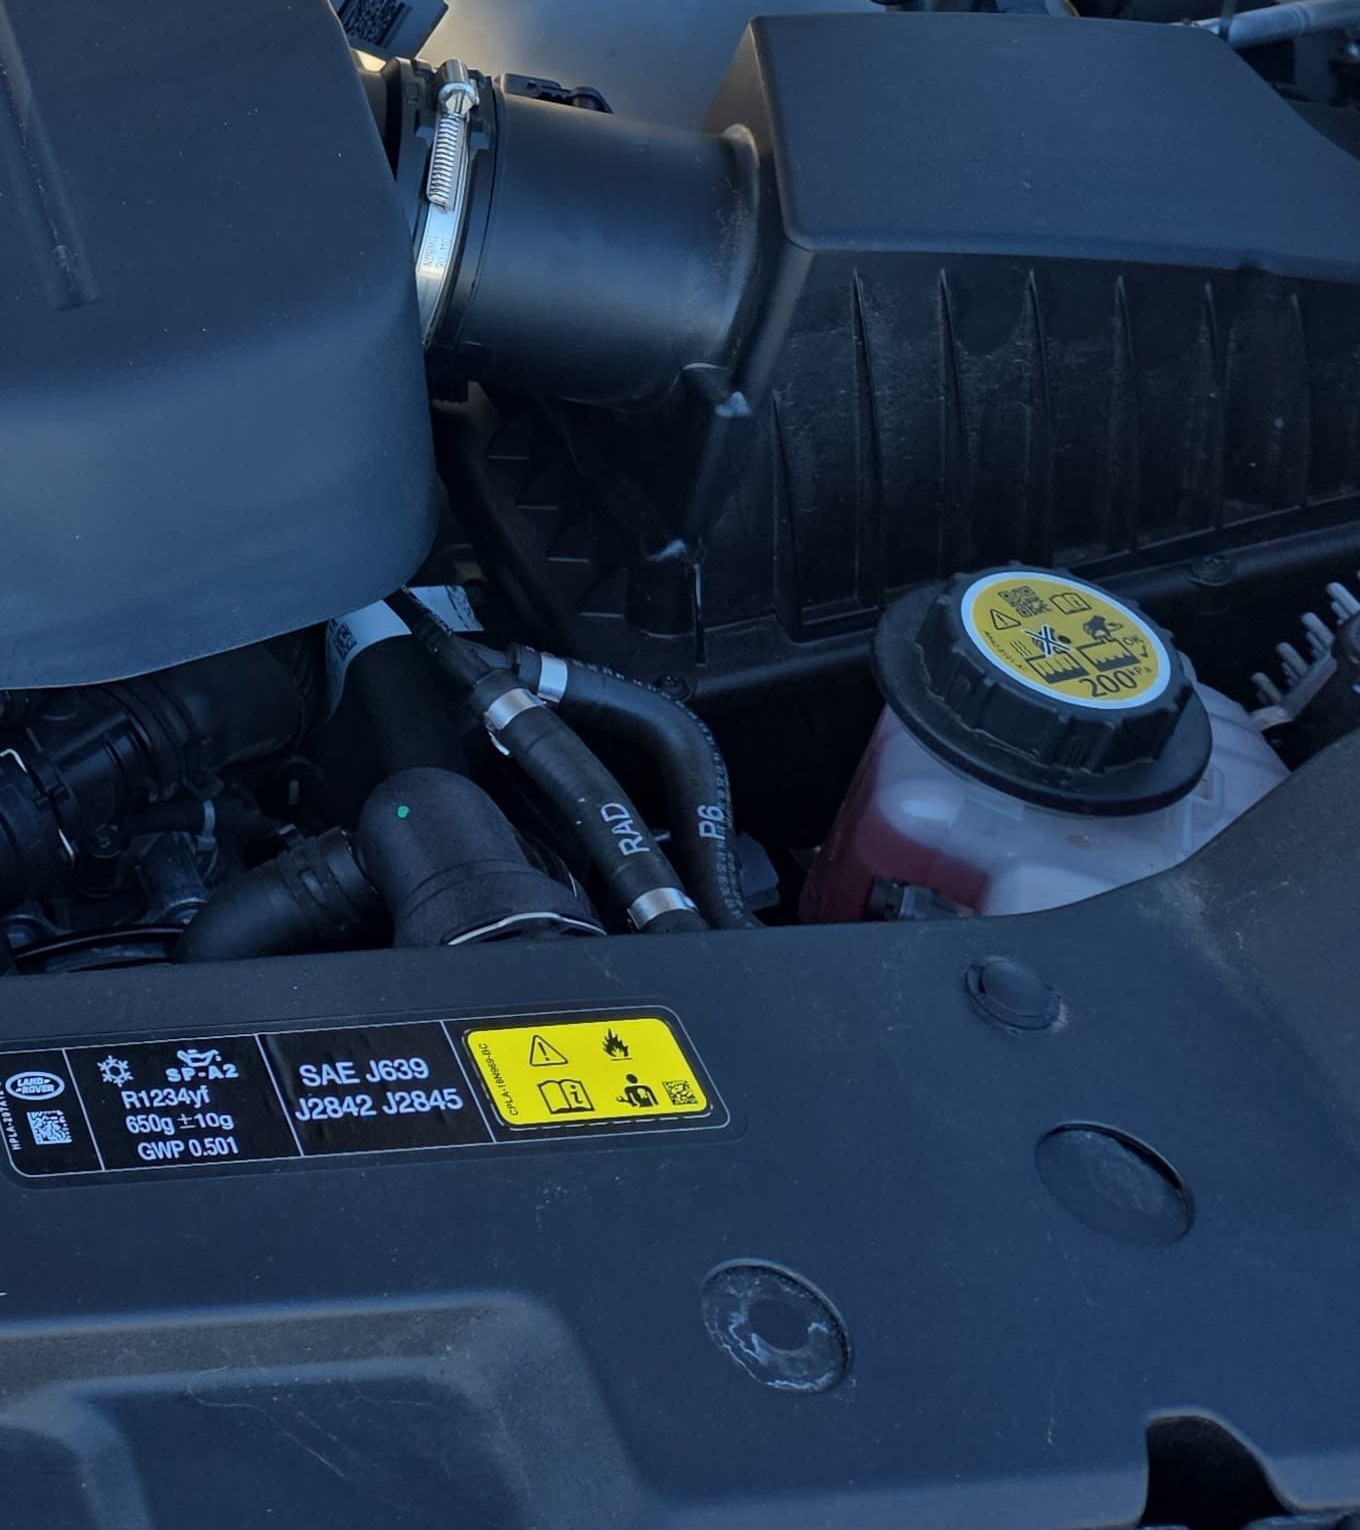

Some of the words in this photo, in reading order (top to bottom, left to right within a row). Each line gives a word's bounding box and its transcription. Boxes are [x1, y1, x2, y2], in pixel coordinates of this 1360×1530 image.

[1078, 671, 1137, 698] 200
[600, 802, 650, 856] RAD
[697, 804, 726, 840] P6
[17, 1077, 44, 1087] LAND
[165, 1063, 240, 1083] SP-A2
[298, 1061, 361, 1087] SAE
[365, 1057, 430, 1083] J639
[21, 1084, 55, 1094] ROVER
[120, 1085, 210, 1110] R1234yf
[294, 1093, 377, 1122] J2842
[382, 1087, 464, 1116] J2845
[125, 1116, 176, 1135] 650g
[176, 1111, 235, 1131] ±10g
[137, 1142, 185, 1162] GWP
[187, 1136, 240, 1158] 0.501
